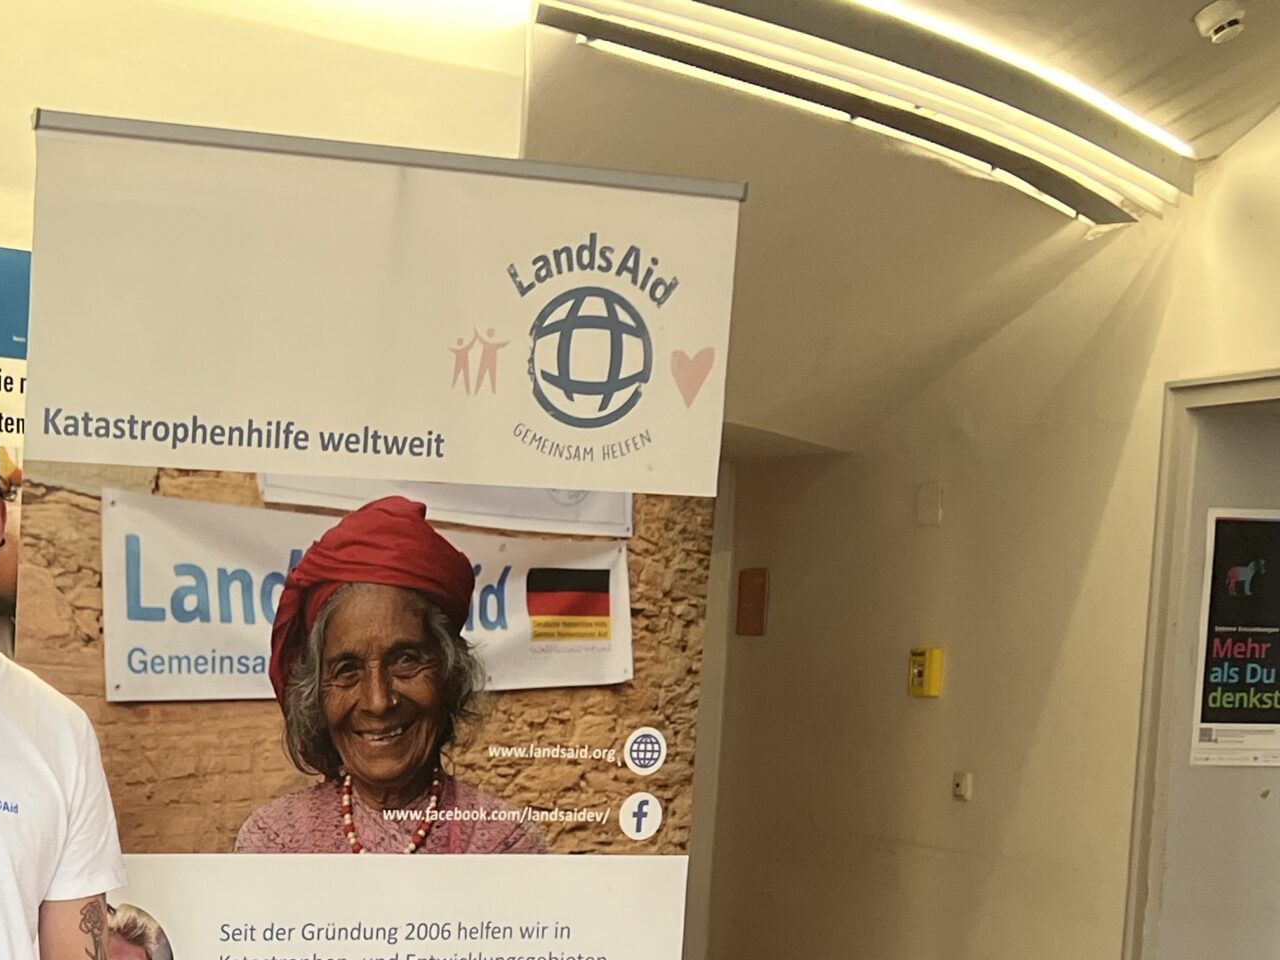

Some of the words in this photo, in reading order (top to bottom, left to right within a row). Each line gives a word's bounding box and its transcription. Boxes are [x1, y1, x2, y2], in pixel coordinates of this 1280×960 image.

[43, 407, 310, 451] Katastrophenhilfe
[319, 426, 445, 458] weltweit
[513, 423, 594, 462] GEMEINSAM
[602, 429, 652, 461] HELFEN
[1212, 637, 1271, 659] Mehr
[1210, 662, 1240, 683] als
[1245, 663, 1276, 684] Du
[1208, 686, 1280, 708] denkst
[488, 744, 617, 763] www.landsaid.org
[382, 806, 611, 825] www.facebook.com/landsaidev/
[220, 924, 256, 942] Seit
[262, 923, 295, 942] der
[301, 922, 398, 945] Gründung
[404, 922, 451, 941] 2006
[457, 921, 513, 940] helfen
[519, 921, 548, 940] wir
[554, 921, 571, 939] in
